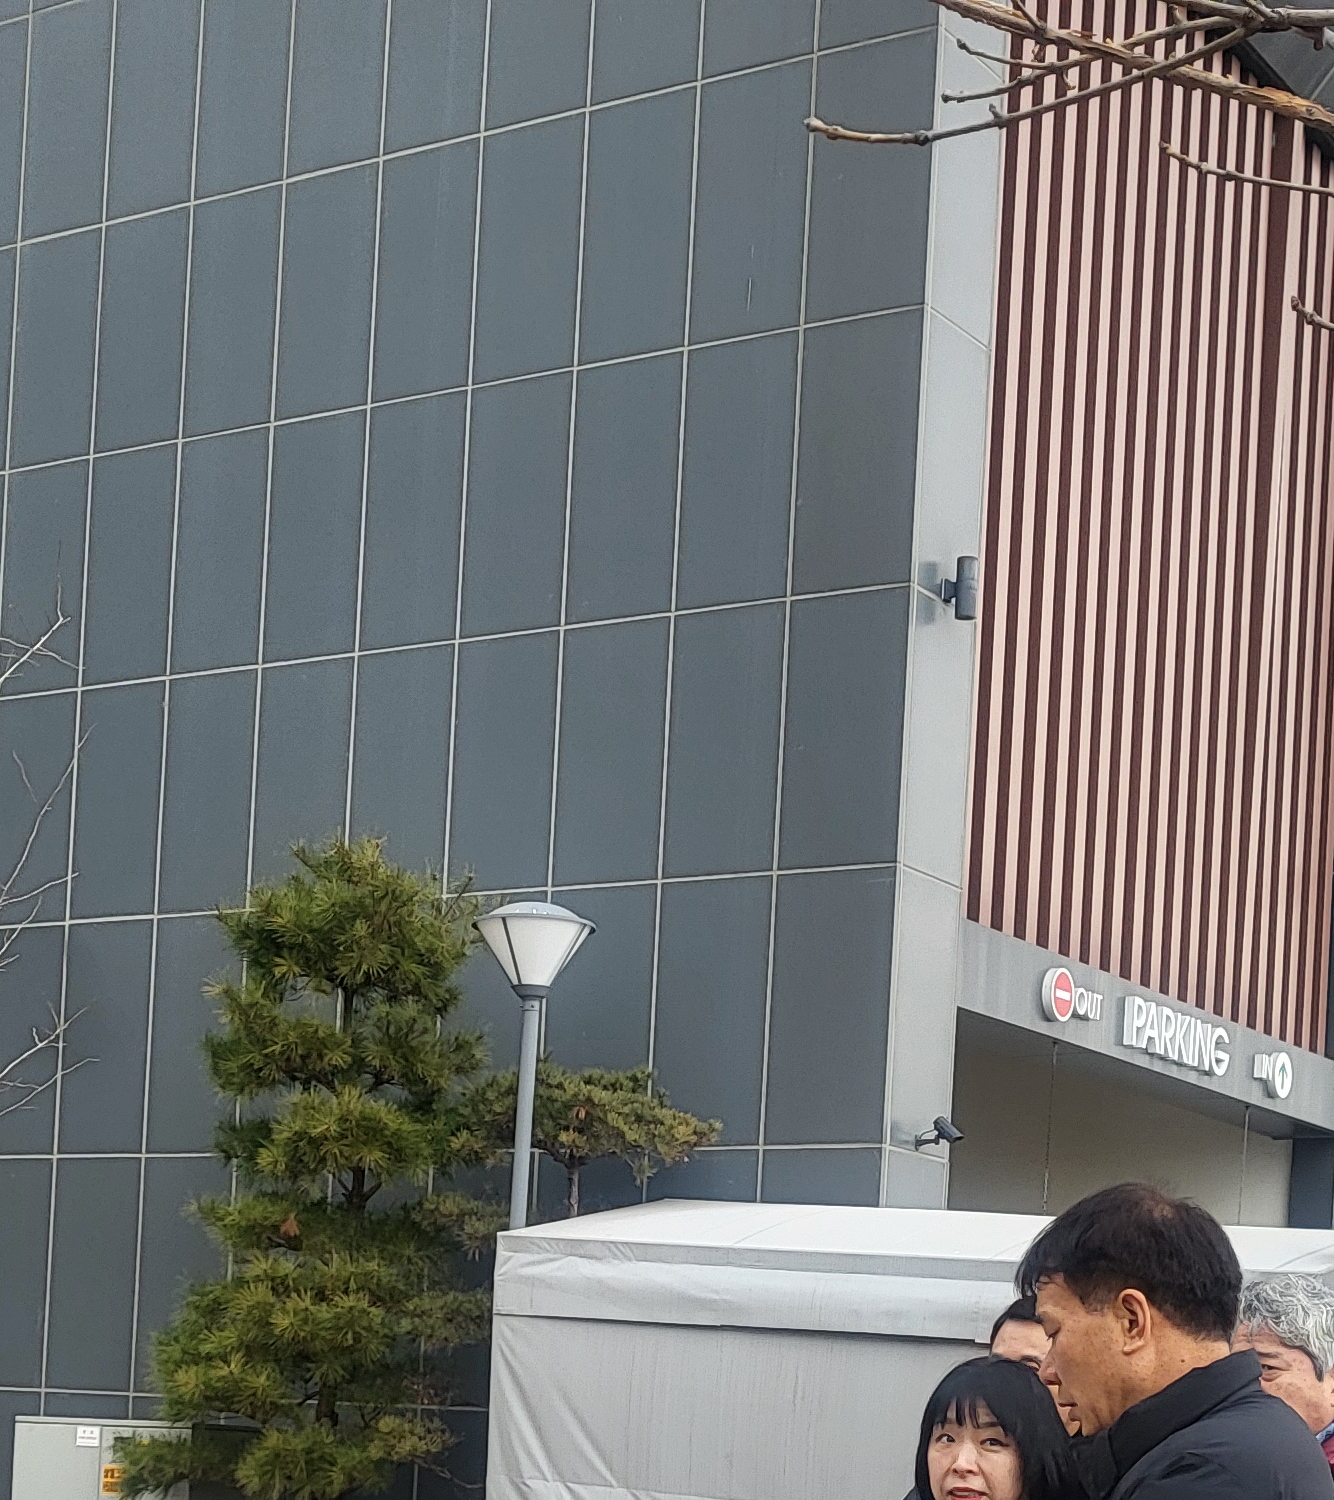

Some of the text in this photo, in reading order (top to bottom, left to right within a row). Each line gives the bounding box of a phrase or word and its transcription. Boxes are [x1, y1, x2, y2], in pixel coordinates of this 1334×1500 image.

[1075, 987, 1103, 1020] OUT
[1124, 996, 1230, 1076] PARKING
[1254, 1053, 1273, 1080] IN
